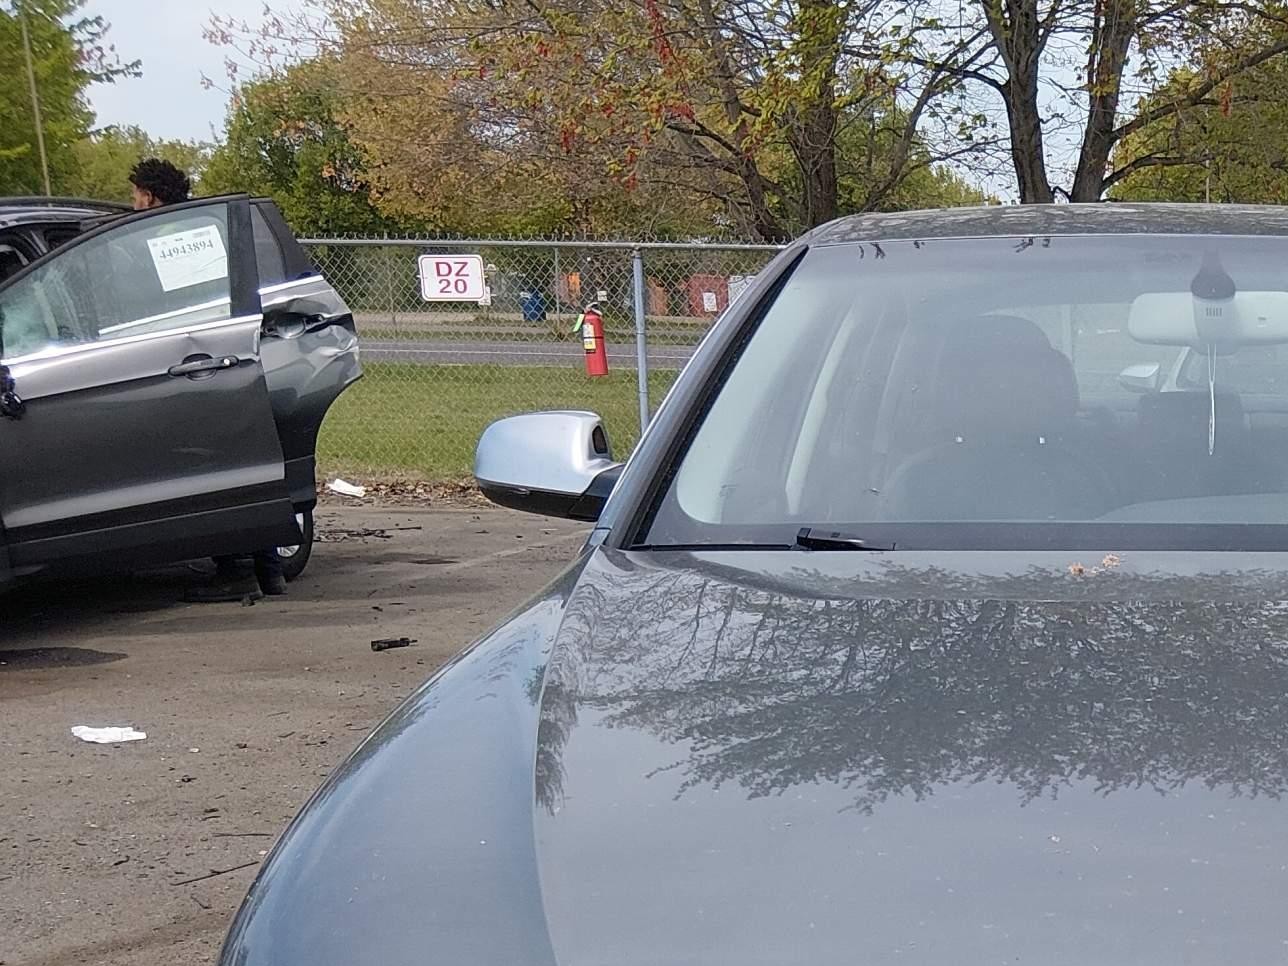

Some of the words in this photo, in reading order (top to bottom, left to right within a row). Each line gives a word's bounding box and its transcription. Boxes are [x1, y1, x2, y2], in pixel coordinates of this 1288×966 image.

[159, 239, 214, 259] 44943894
[435, 261, 470, 277] DZ
[438, 279, 468, 294] 20
